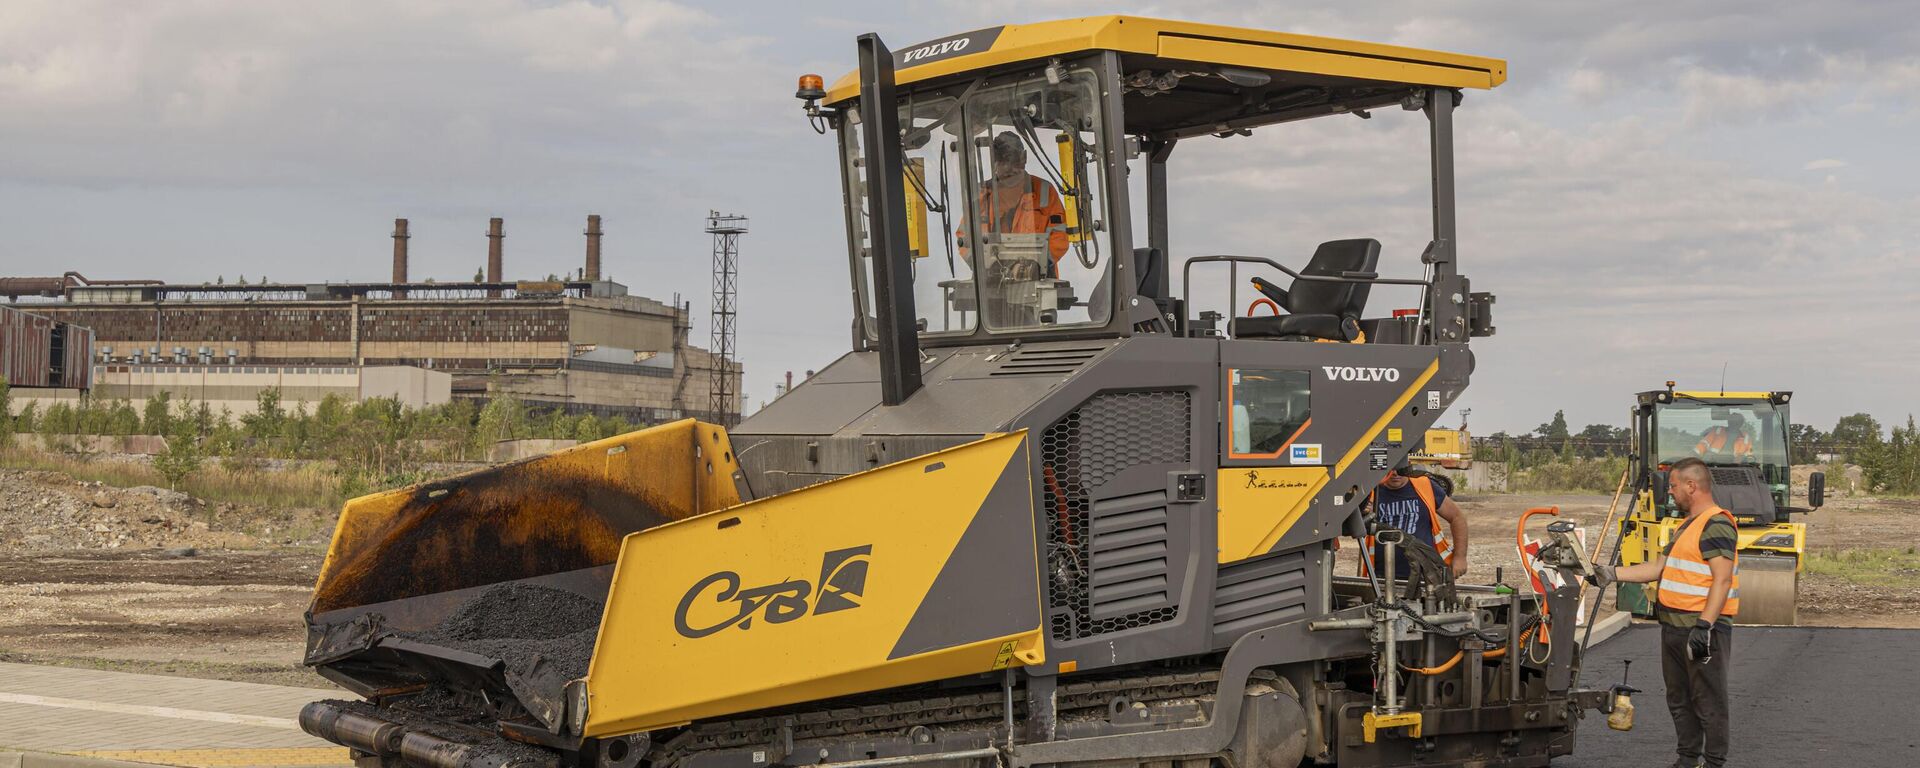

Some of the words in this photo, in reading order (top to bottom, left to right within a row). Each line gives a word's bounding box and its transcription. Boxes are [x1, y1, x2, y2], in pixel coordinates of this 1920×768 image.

[904, 38, 970, 63] VOLVO
[1322, 366, 1400, 382] VOLVO
[1379, 499, 1420, 517] SAILING
